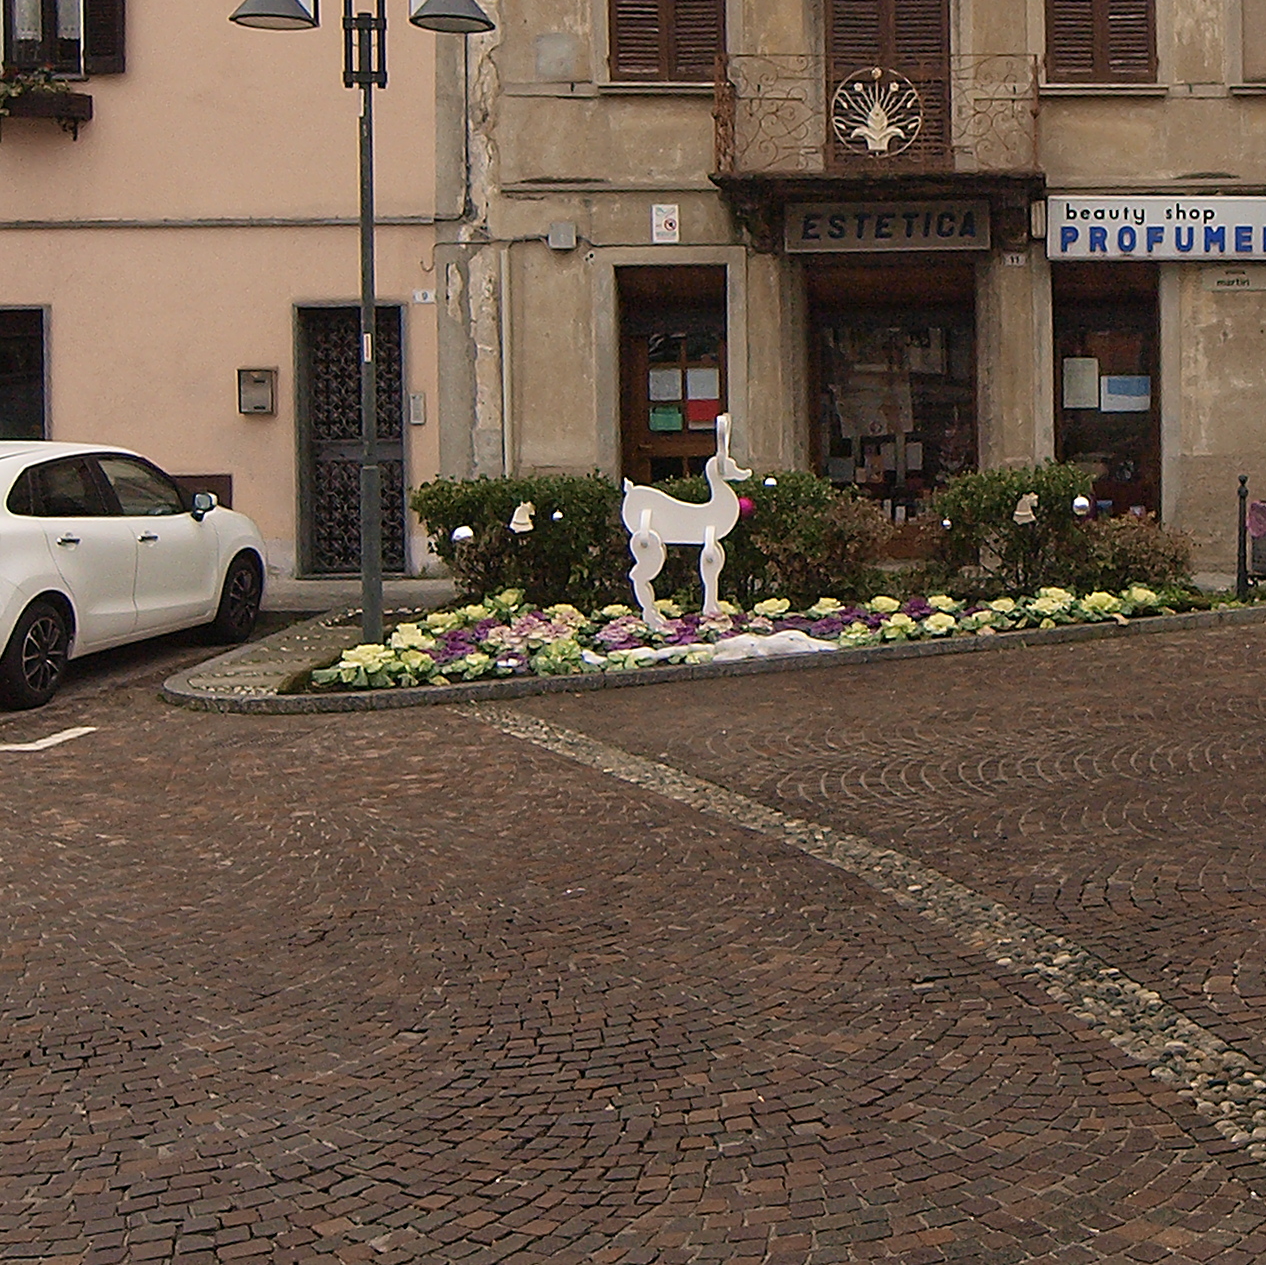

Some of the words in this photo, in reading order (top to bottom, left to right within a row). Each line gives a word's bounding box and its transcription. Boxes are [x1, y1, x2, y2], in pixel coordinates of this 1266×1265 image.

[802, 211, 976, 240] ESTETICA
[1066, 203, 1145, 225] beauty
[1165, 203, 1215, 224] shop
